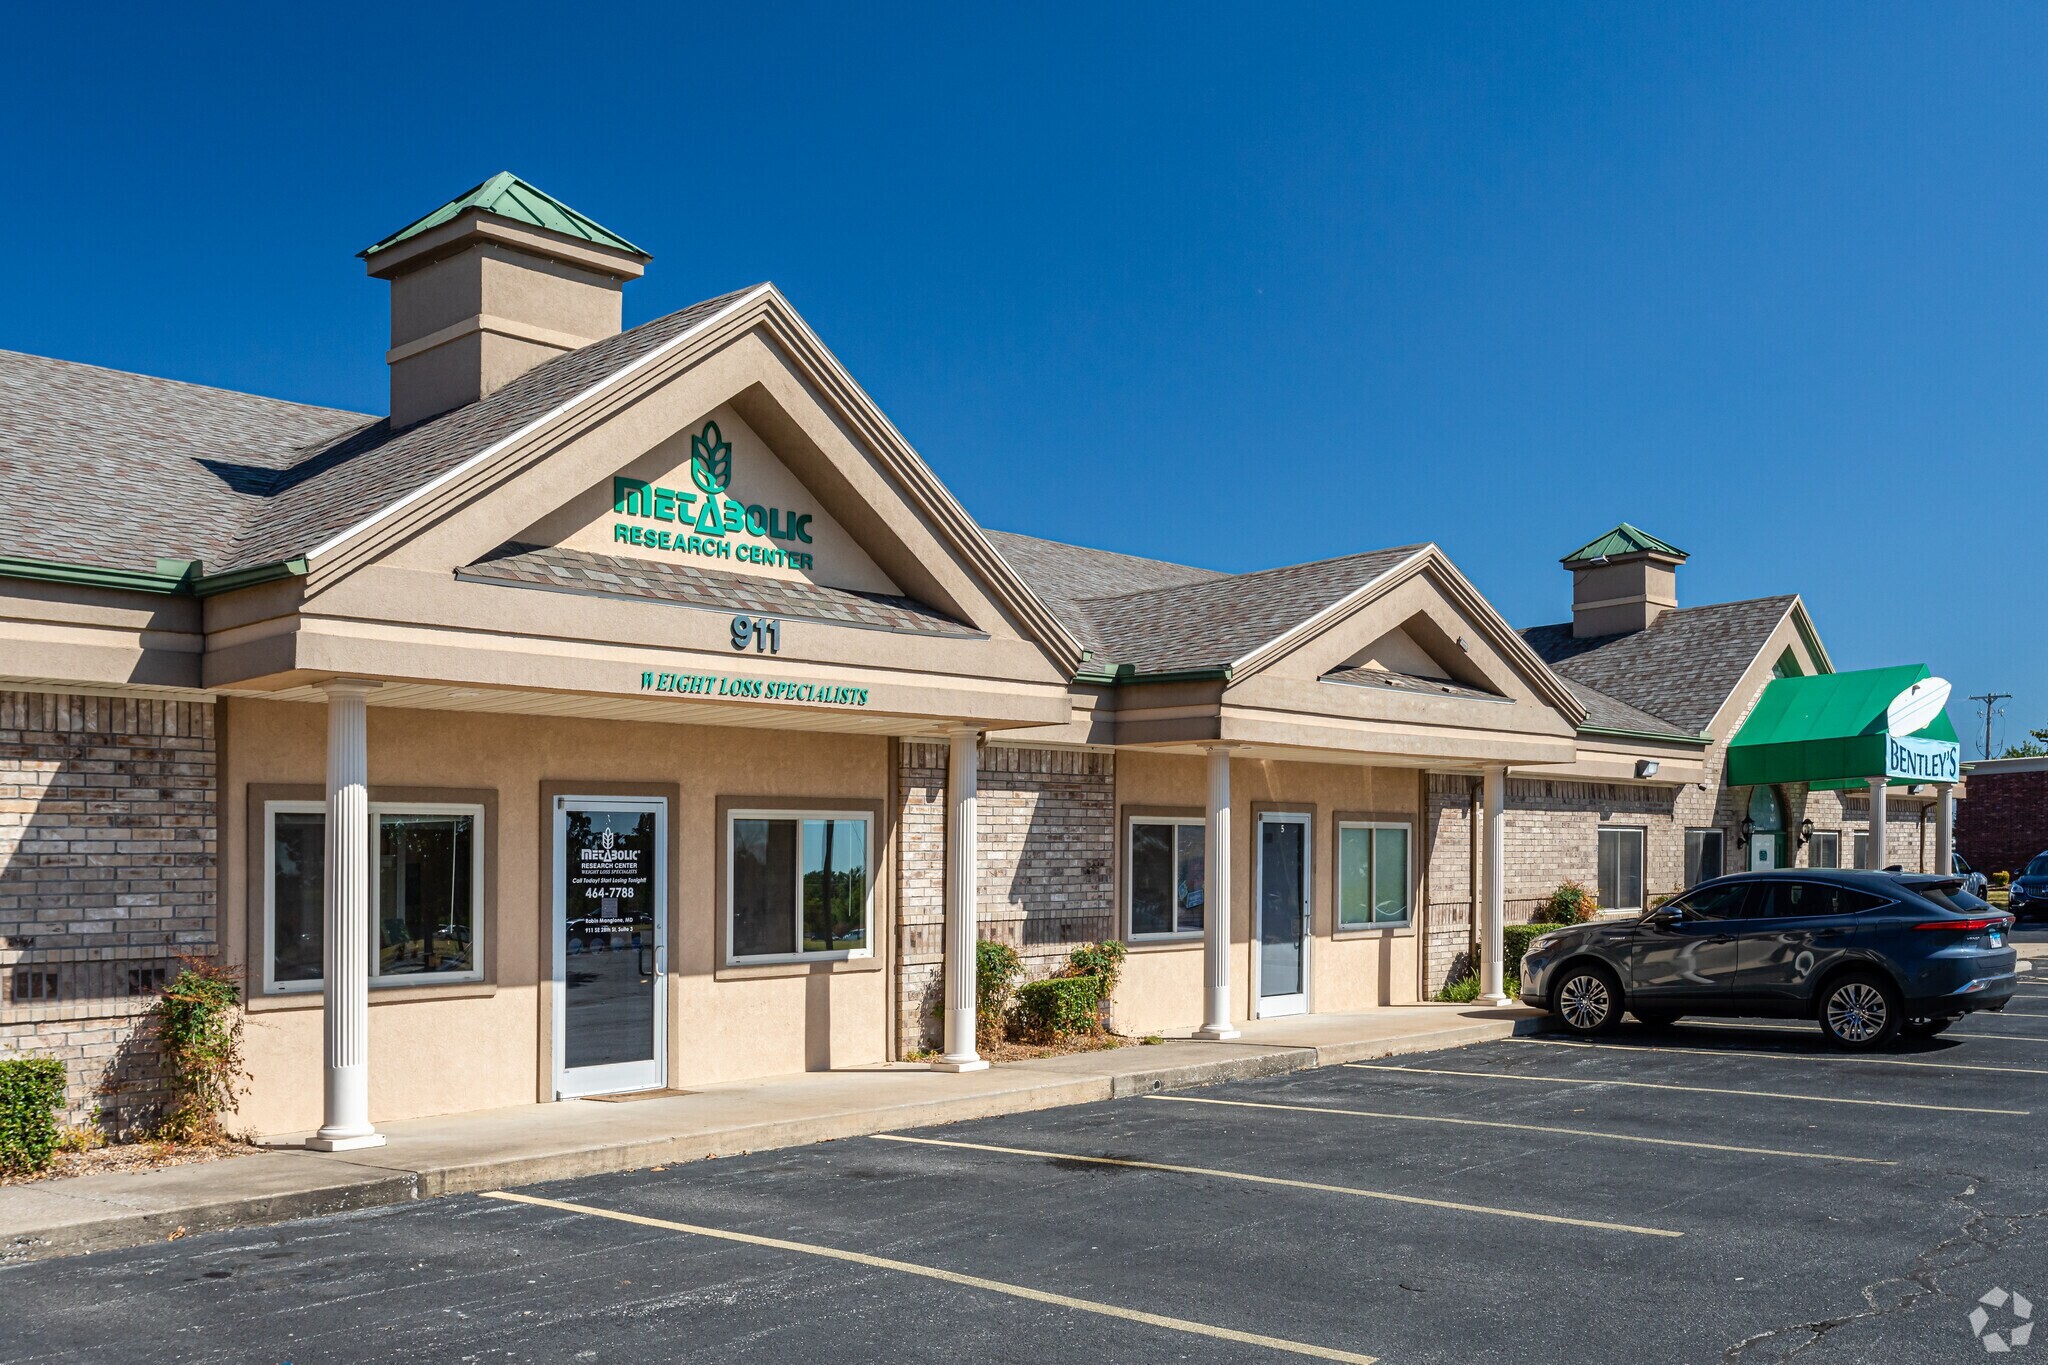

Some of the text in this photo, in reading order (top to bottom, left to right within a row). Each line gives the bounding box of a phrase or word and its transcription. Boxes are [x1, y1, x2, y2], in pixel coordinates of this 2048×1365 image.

[614, 476, 812, 544] METABOLIC
[614, 523, 813, 570] RESEARCH CENTER
[730, 615, 780, 653] 911
[719, 678, 763, 698] LOSS
[765, 682, 868, 706] SPECIALISTS
[1890, 738, 1957, 777] BENTLEY'S
[1281, 824, 1285, 833] 5
[585, 887, 634, 898] 464-7788
